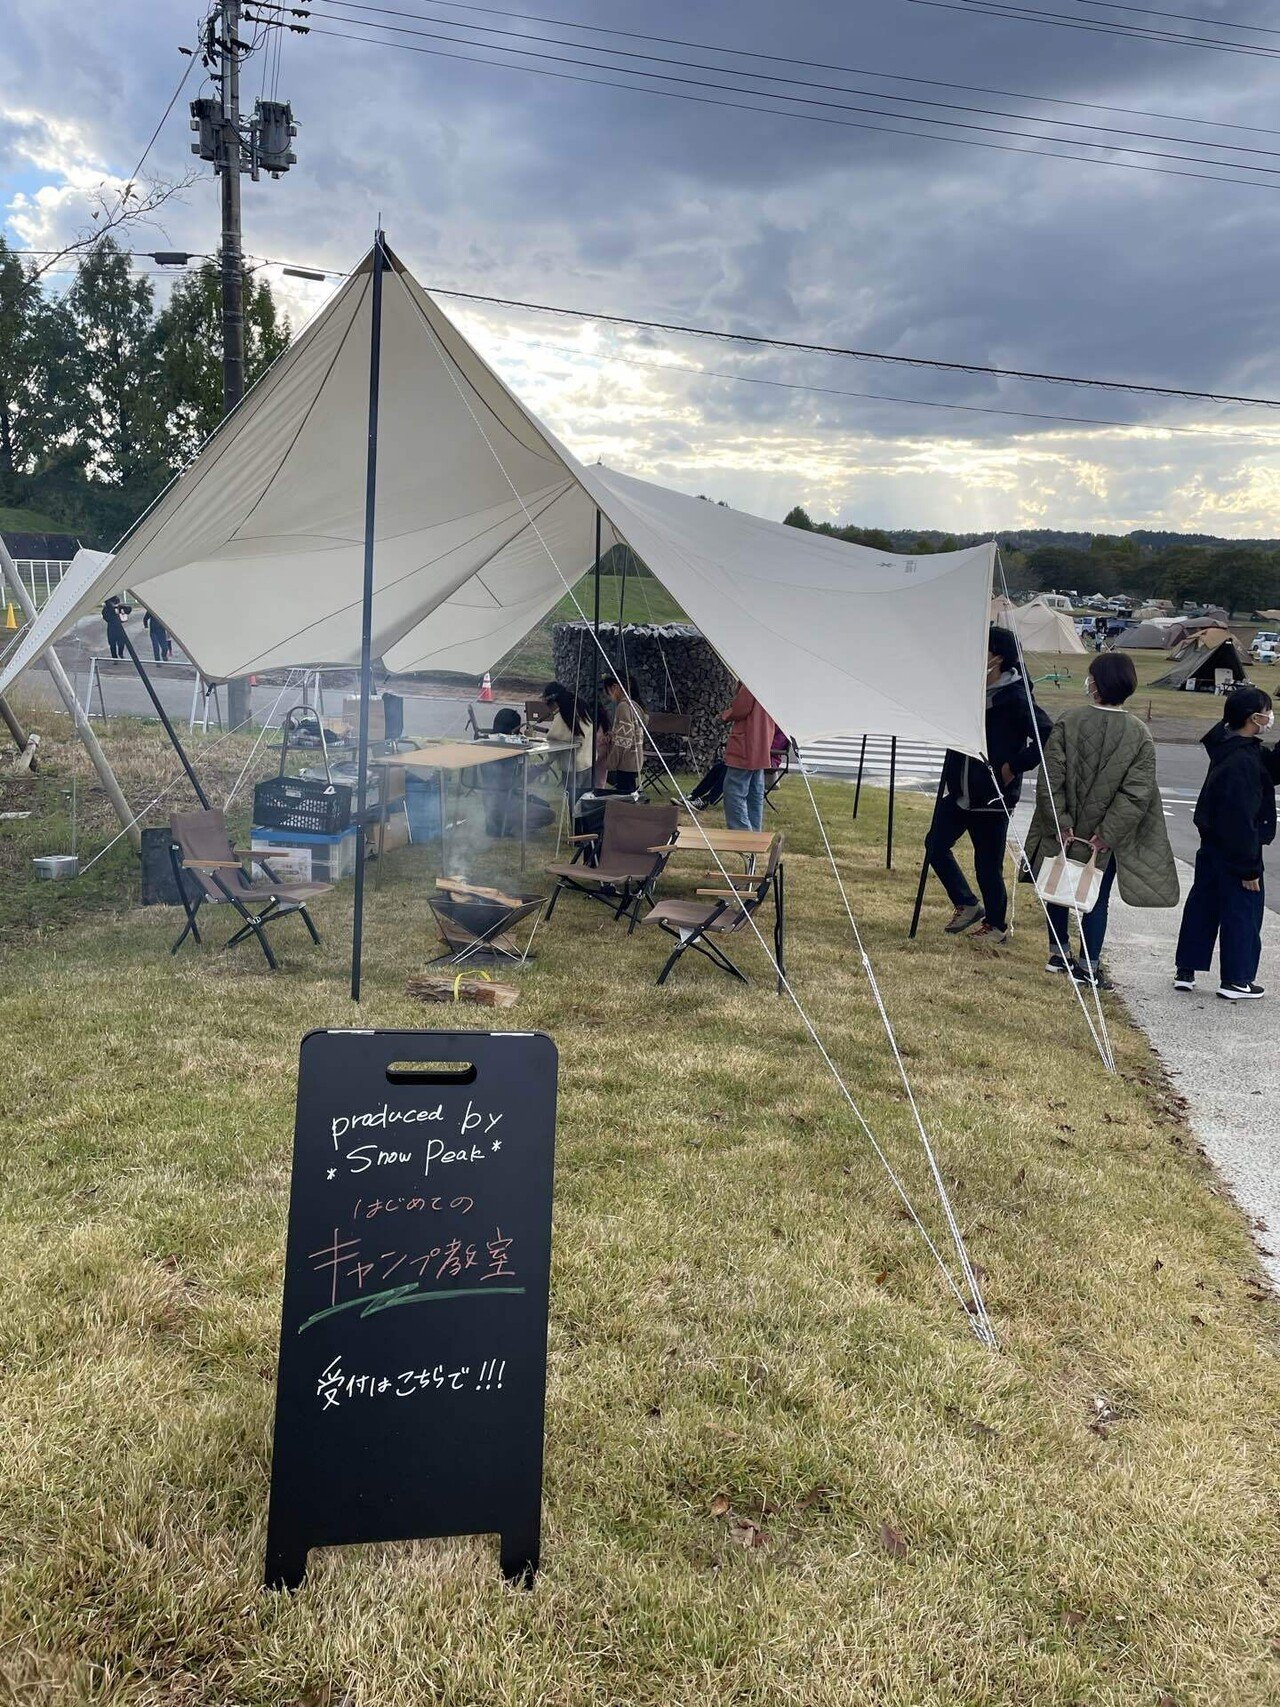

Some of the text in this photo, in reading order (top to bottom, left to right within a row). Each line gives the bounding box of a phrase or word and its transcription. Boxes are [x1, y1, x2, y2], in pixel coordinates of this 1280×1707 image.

[332, 1100, 503, 1150] produced by
[346, 1144, 412, 1174] Snow
[354, 1196, 475, 1220] はじめての
[308, 1226, 517, 1307] キャンプ教室
